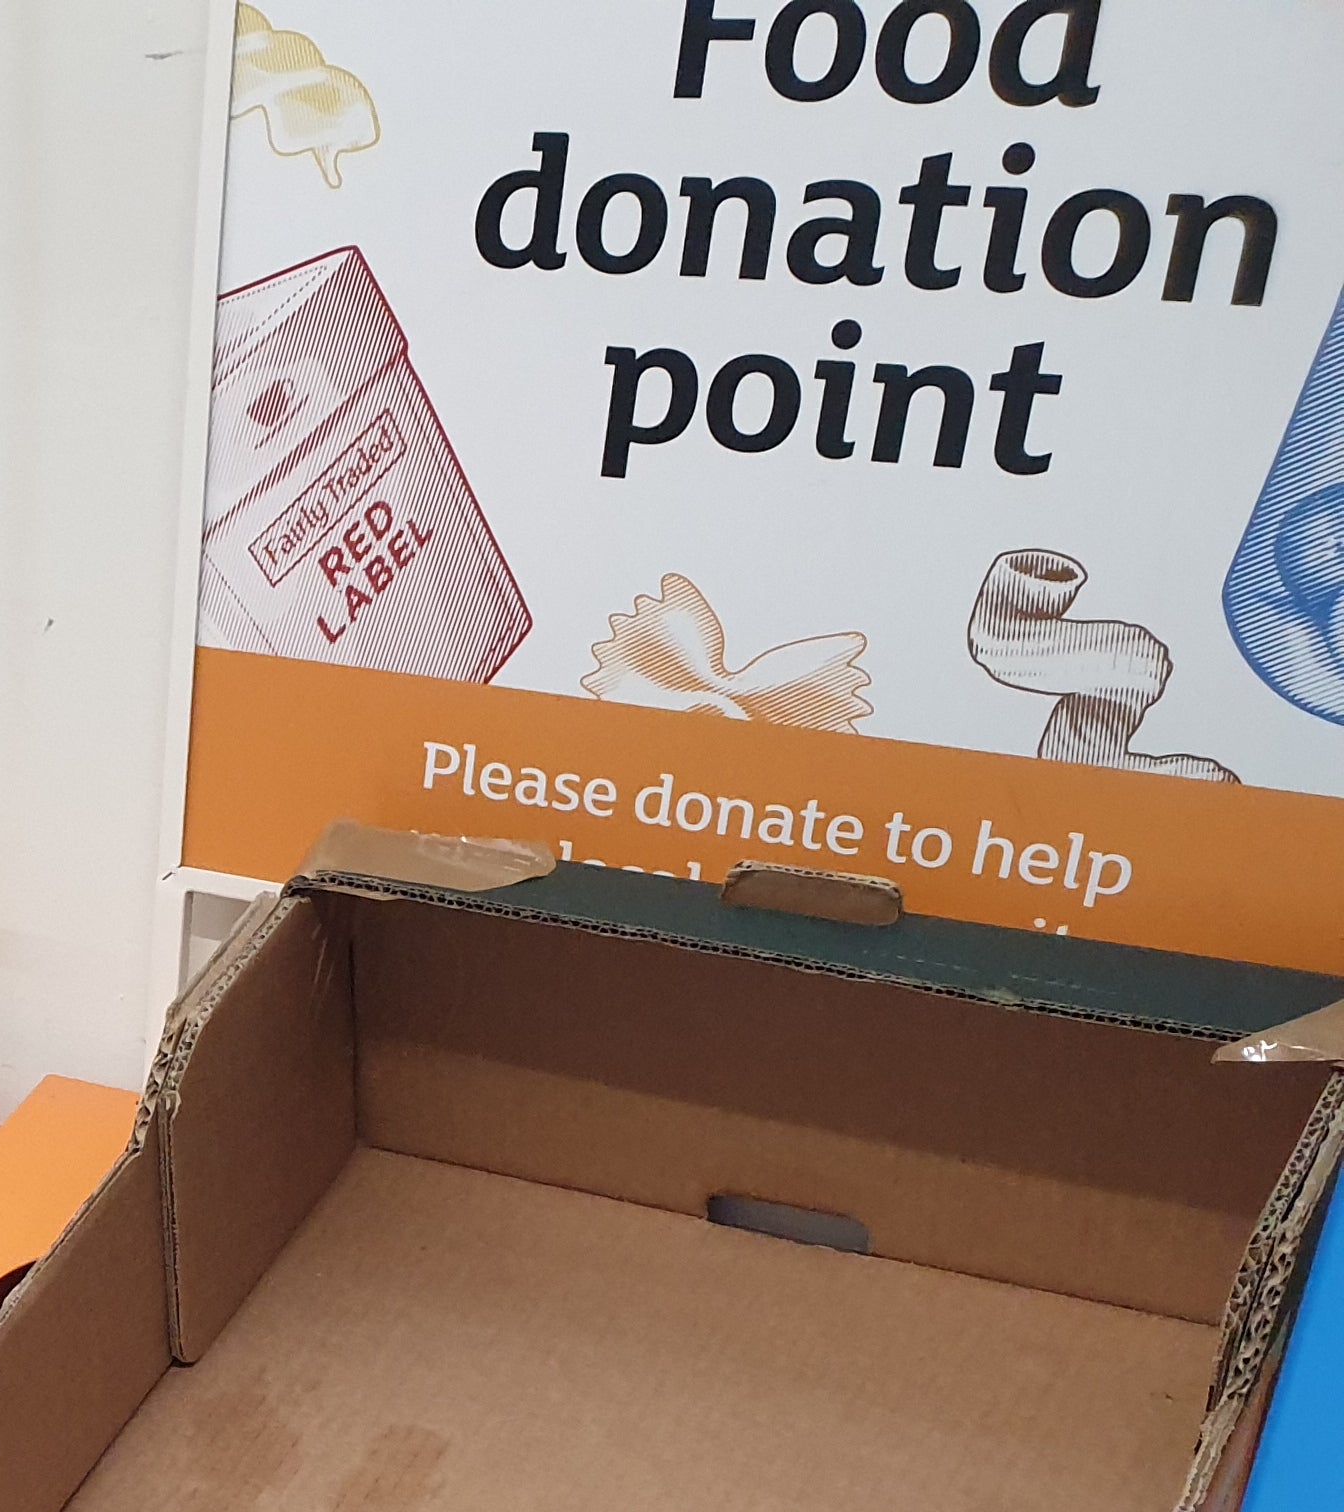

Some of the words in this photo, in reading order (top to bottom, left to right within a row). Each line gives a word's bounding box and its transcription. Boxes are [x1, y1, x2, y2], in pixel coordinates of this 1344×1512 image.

[673, 0, 1102, 106] Food
[473, 132, 1280, 308] donation
[599, 318, 1065, 478] point
[263, 502, 330, 566] Fairly
[322, 426, 395, 501] Traded
[317, 501, 394, 588] RED
[316, 518, 434, 644] LABEL
[422, 741, 617, 817] Please
[634, 774, 865, 856] donate
[885, 811, 953, 869] to
[971, 820, 1133, 908] help
